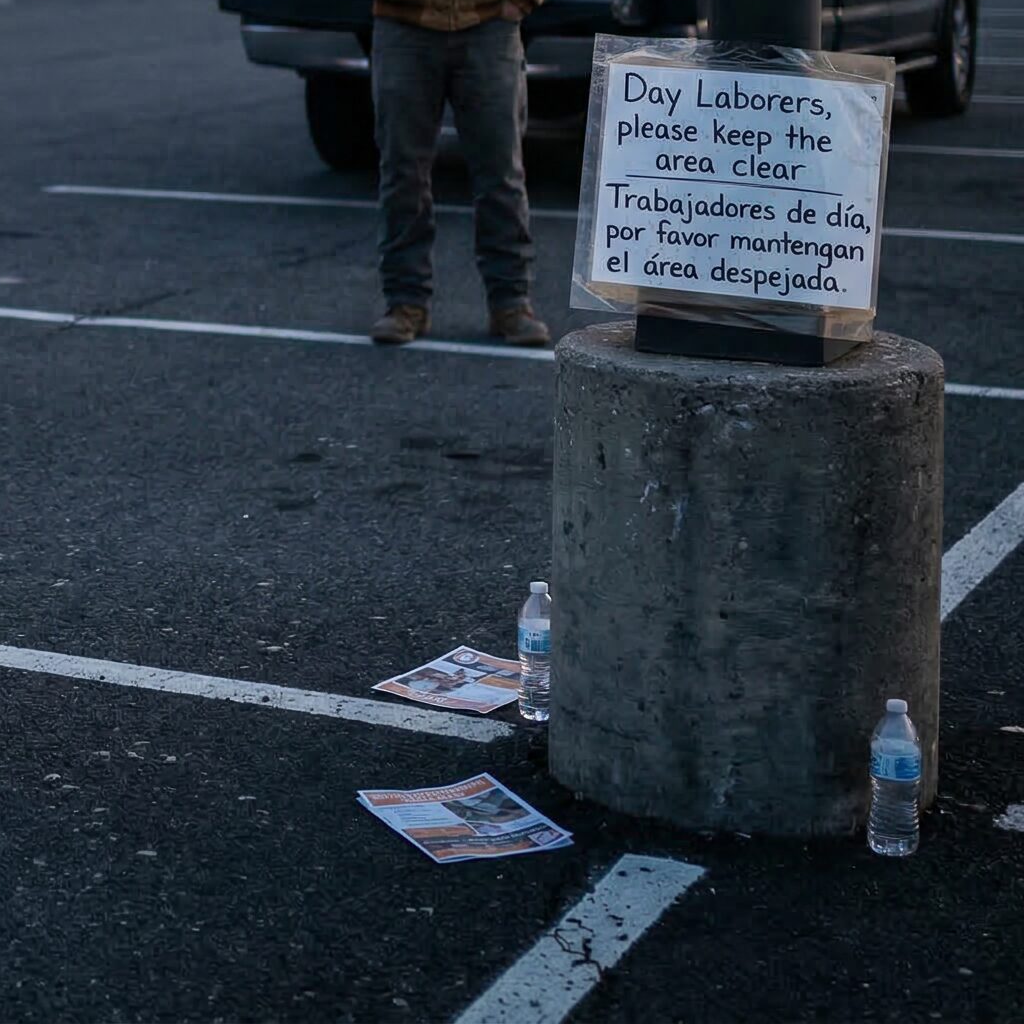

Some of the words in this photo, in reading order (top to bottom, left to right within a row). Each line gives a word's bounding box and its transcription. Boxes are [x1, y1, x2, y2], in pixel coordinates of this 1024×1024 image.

[624, 72, 682, 117] Day
[696, 79, 832, 121] Laborers,
[618, 114, 698, 145] please
[713, 118, 773, 155] keep
[785, 124, 833, 153] the
[656, 154, 716, 174] area
[732, 154, 807, 181] clear
[606, 182, 776, 224] Trabajadores
[787, 200, 817, 225] de
[826, 202, 871, 235] día,
[606, 224, 647, 249] por
[656, 220, 720, 249] favor
[730, 231, 865, 268] mantengan
[606, 251, 629, 273] el
[643, 252, 698, 281] área
[711, 258, 848, 296] despejada.
